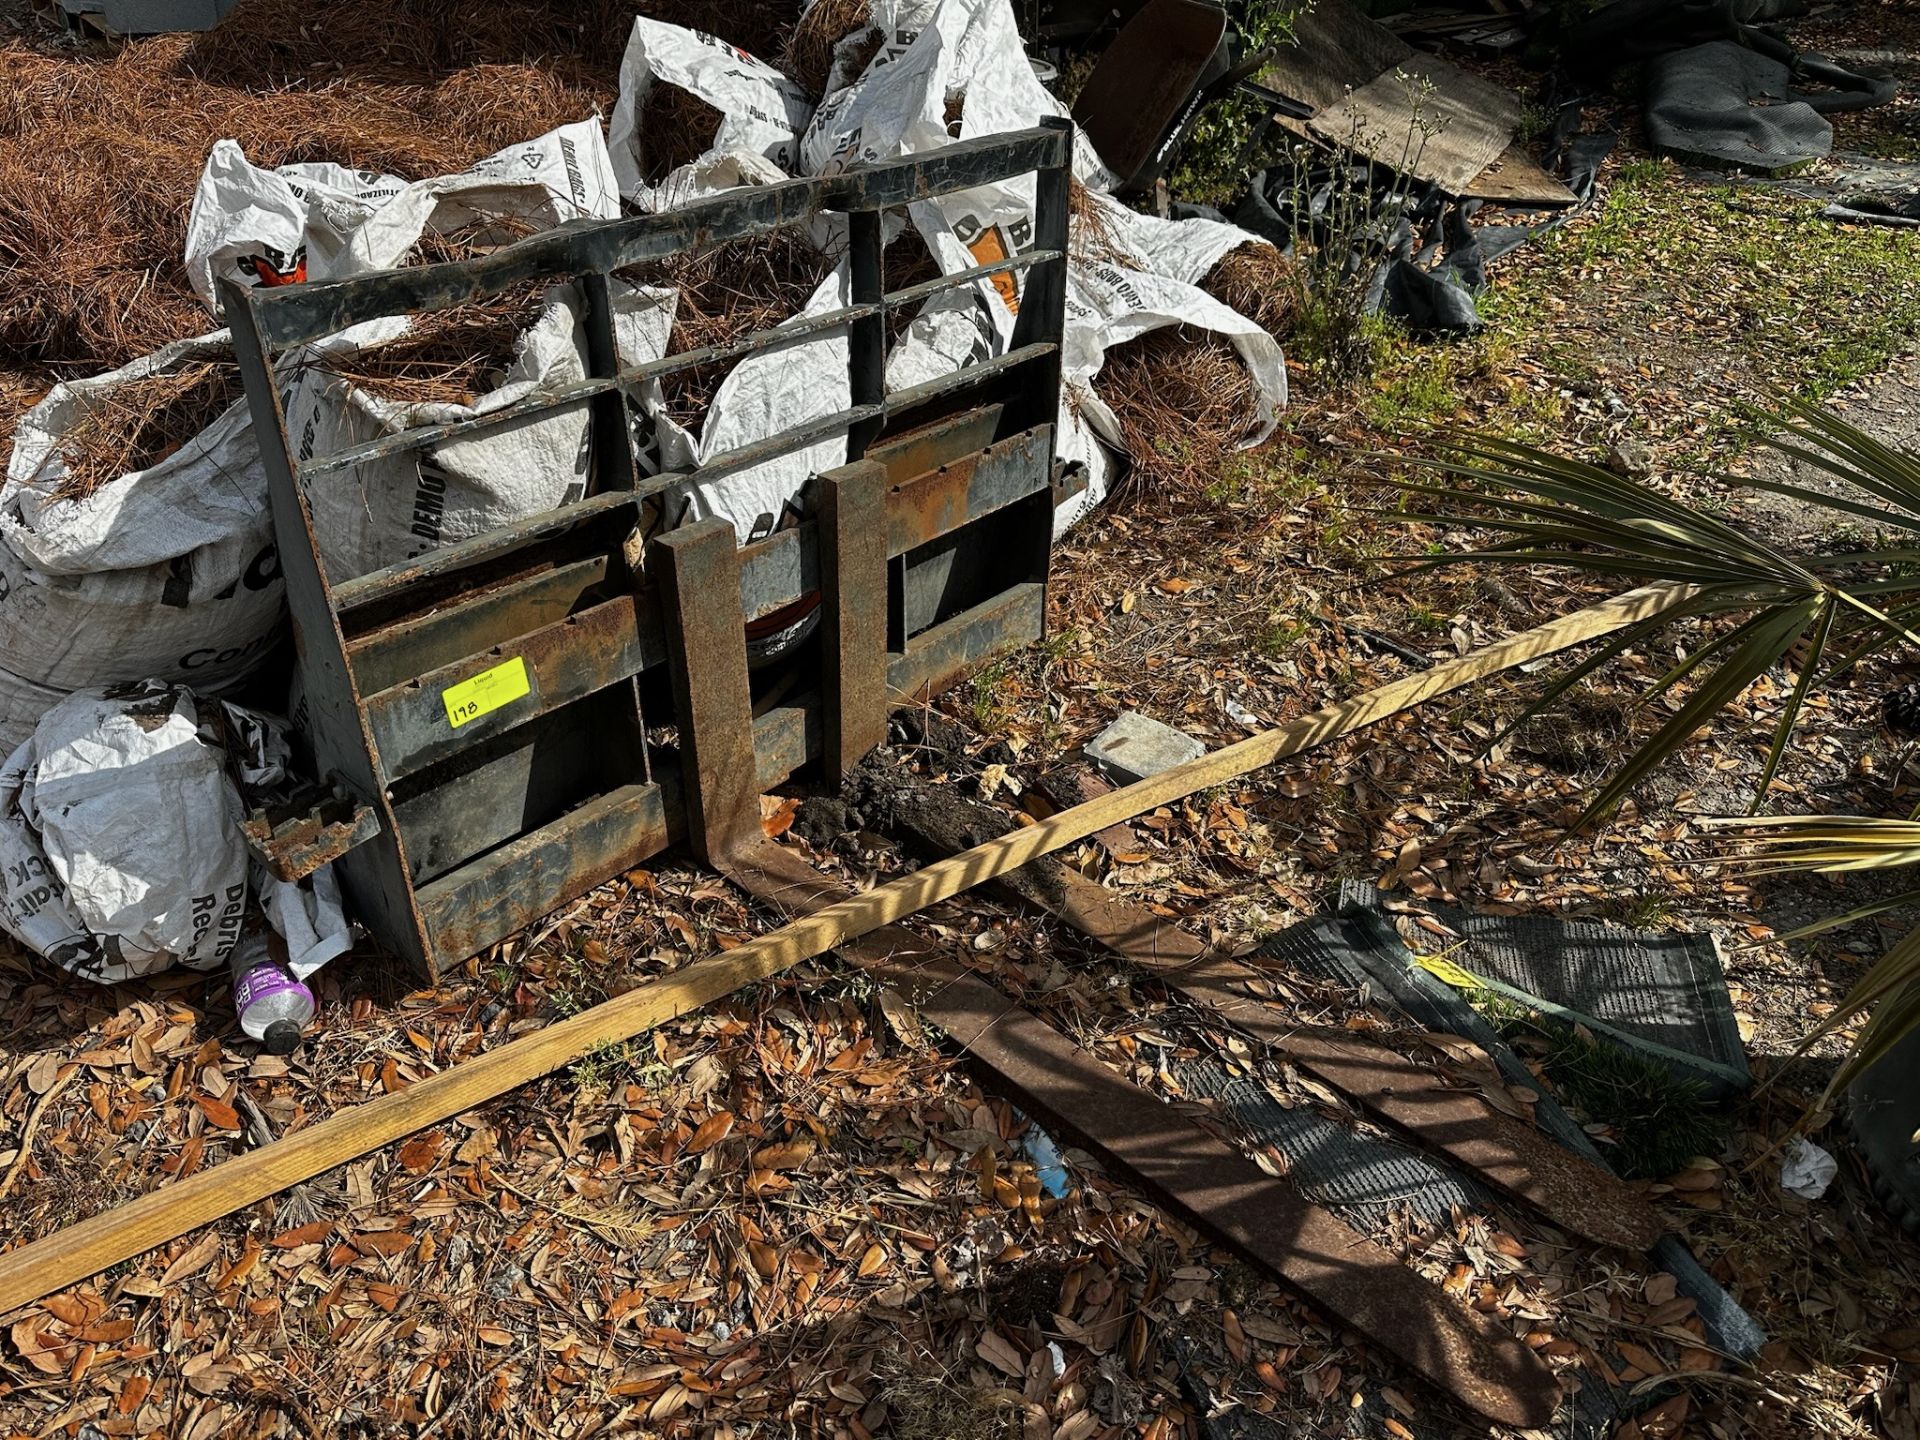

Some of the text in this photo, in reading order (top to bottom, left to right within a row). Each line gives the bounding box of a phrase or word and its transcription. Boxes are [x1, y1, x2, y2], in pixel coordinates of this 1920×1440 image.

[411, 474, 446, 541] DEMO
[453, 701, 478, 722] 198
[215, 881, 246, 958] Debris
